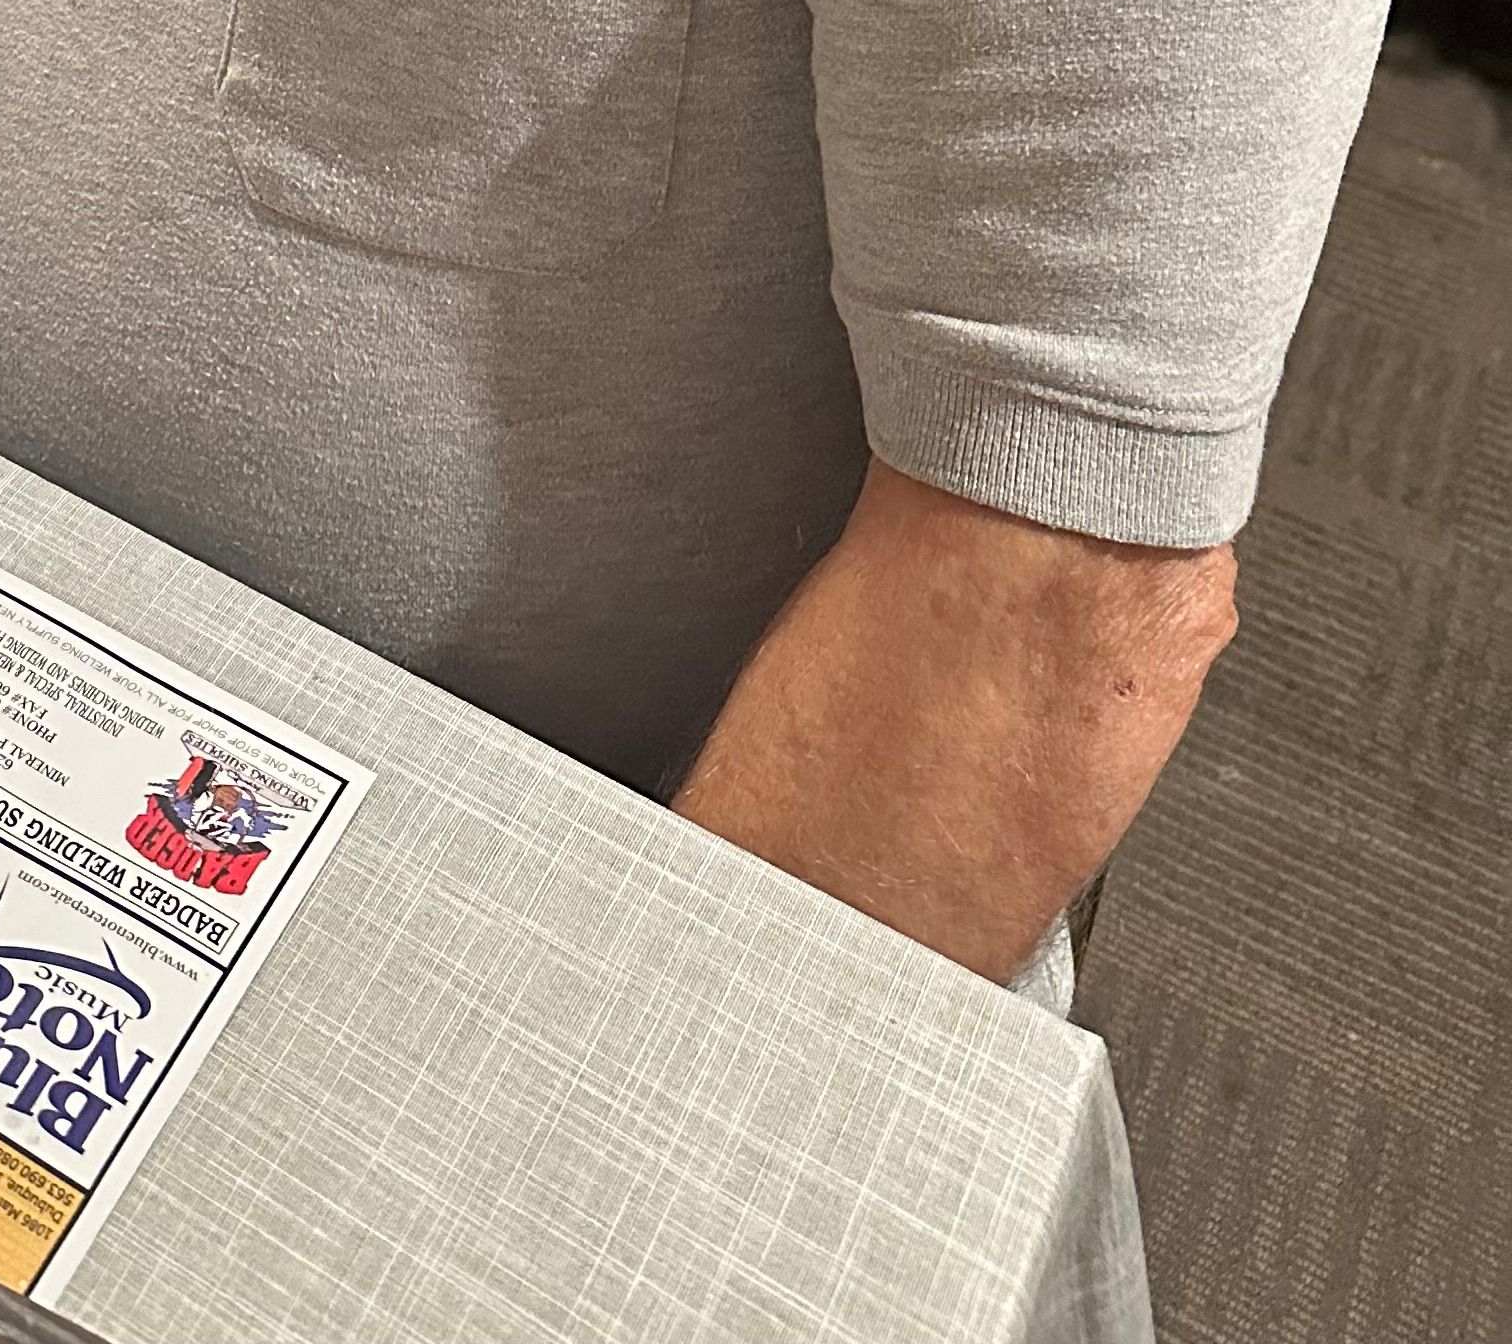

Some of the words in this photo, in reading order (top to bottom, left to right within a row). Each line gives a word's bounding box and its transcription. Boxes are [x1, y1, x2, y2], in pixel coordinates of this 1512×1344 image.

[2, 636, 48, 670] WELDING
[45, 661, 70, 682] AND
[59, 641, 112, 676] WELDING
[23, 668, 64, 701] SPECIAL
[67, 675, 121, 712] MACHINES
[111, 672, 142, 695] YOUR
[1, 705, 57, 743] PHONE#
[10, 693, 48, 719] FAX#
[63, 691, 124, 737] INDUSTRIAL,
[118, 705, 165, 739] WELDING
[191, 718, 228, 739] SHOP
[226, 736, 261, 758] STOP
[9, 742, 70, 786] MINERAL
[261, 753, 288, 772] ONE
[249, 768, 308, 808] WELDING
[23, 818, 126, 887] WELDING
[125, 792, 269, 898] BADGER
[17, 870, 197, 980] www.bluenoterepair.com
[129, 876, 228, 945] BADGER
[34, 965, 132, 1033] Music
[5, 1176, 64, 1224] Dubuque,
